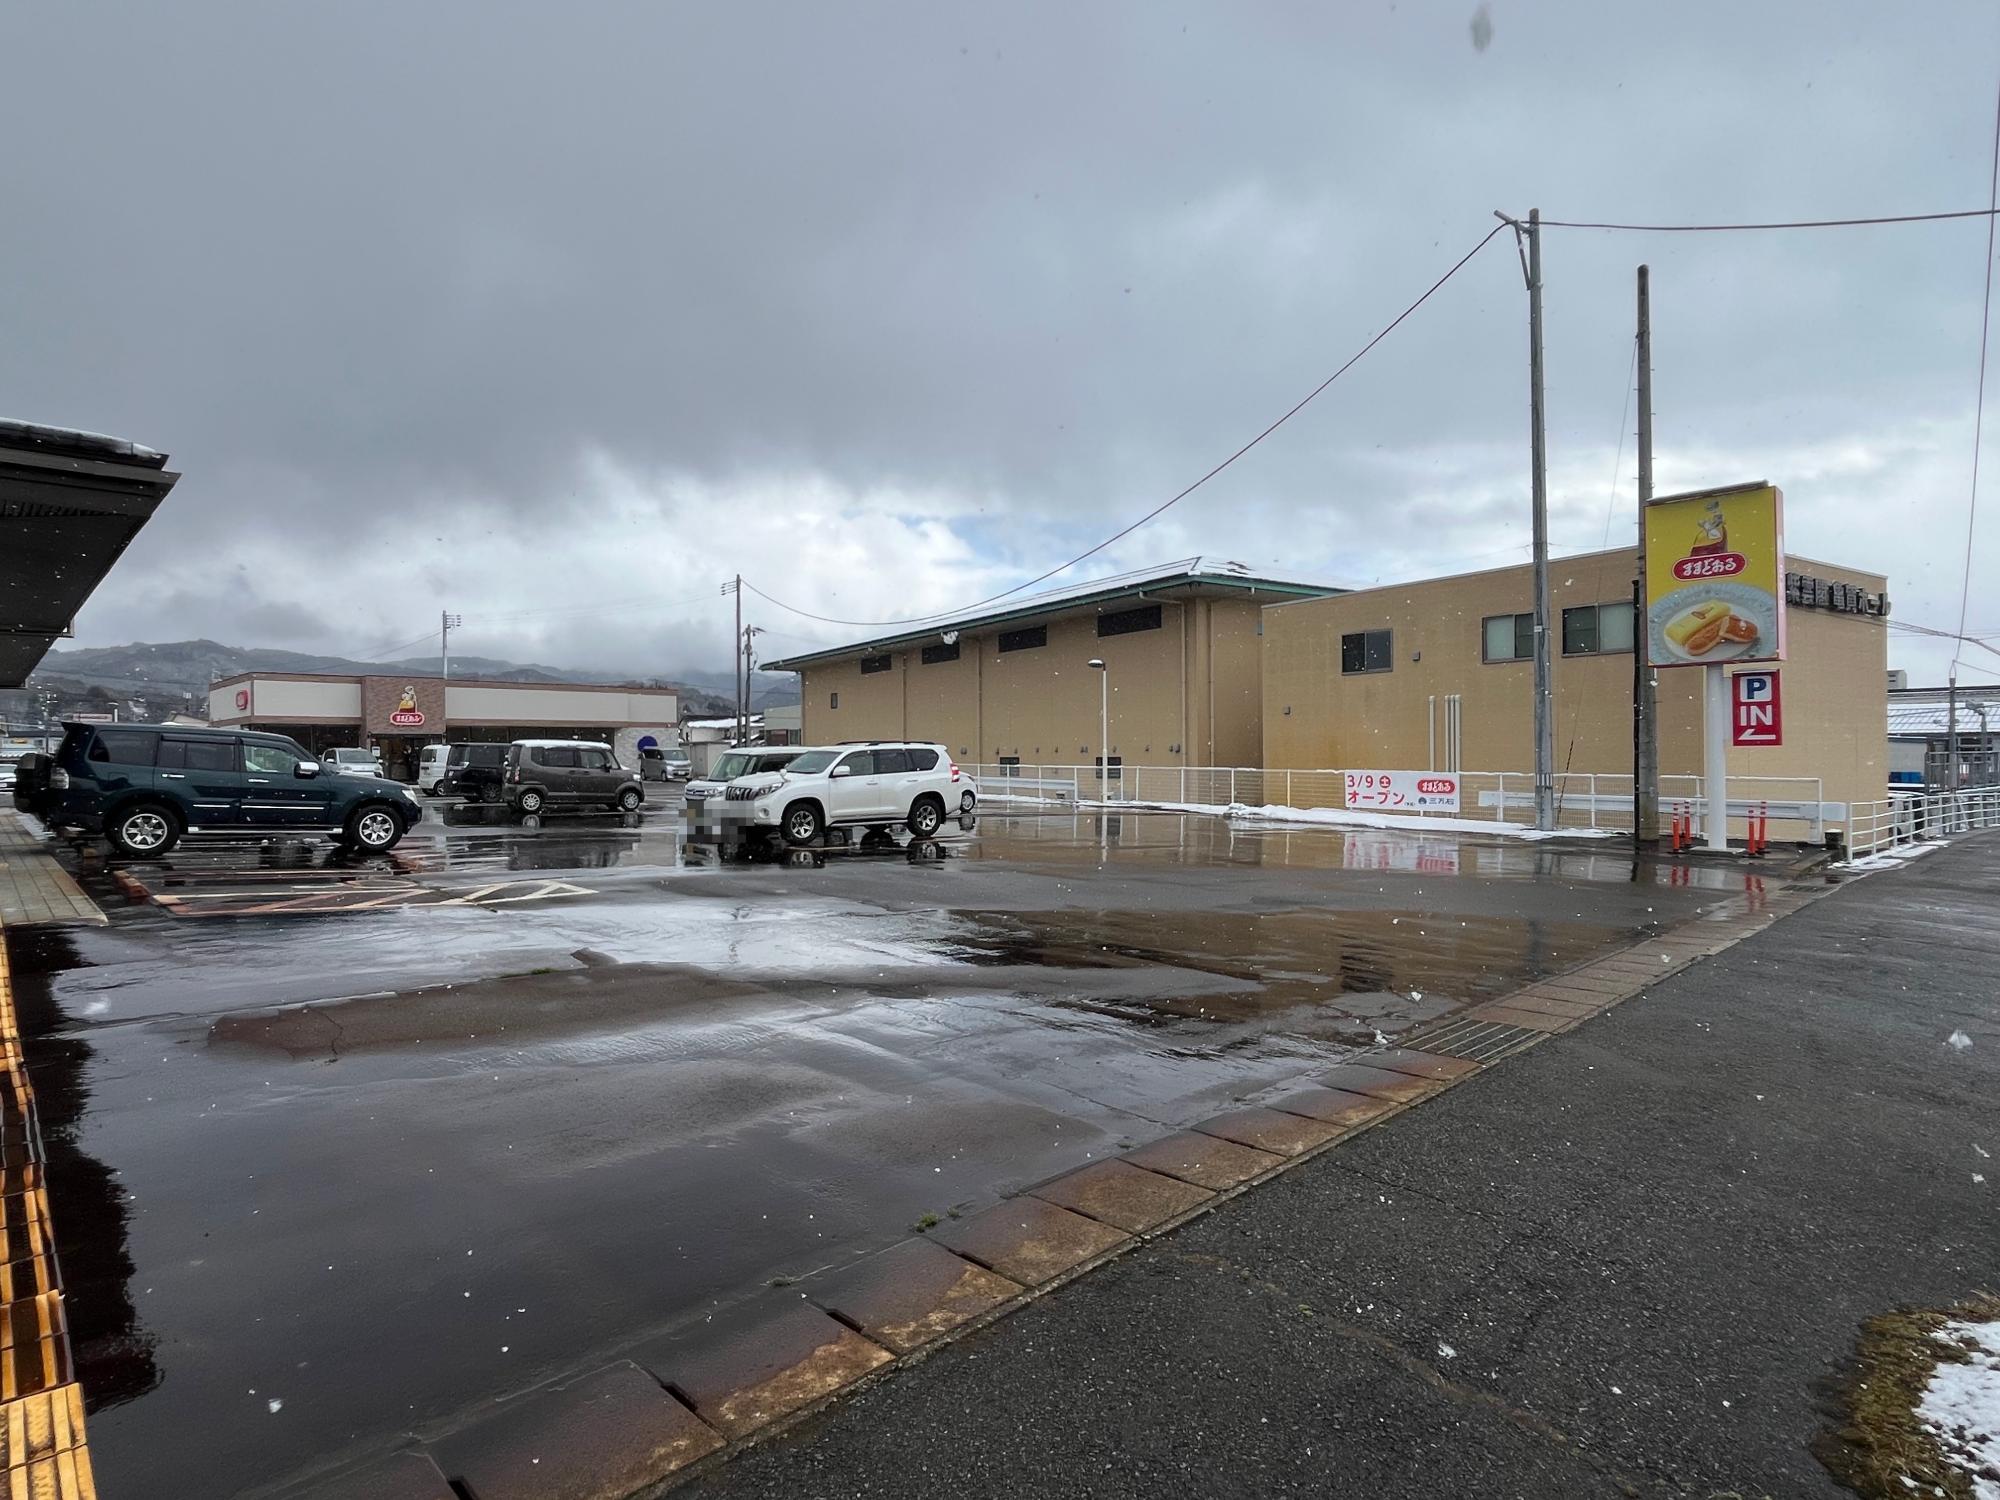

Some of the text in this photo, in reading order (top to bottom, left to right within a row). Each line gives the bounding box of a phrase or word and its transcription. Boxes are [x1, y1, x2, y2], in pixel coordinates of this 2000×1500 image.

[1682, 557, 1736, 576] ままどおる
[1747, 678, 1766, 699] P
[1740, 704, 1772, 726] IN
[1347, 774, 1373, 788] 3/9
[1422, 780, 1451, 793] ままどおる
[1347, 790, 1405, 805] オープン
[1429, 797, 1455, 805] 三万石
